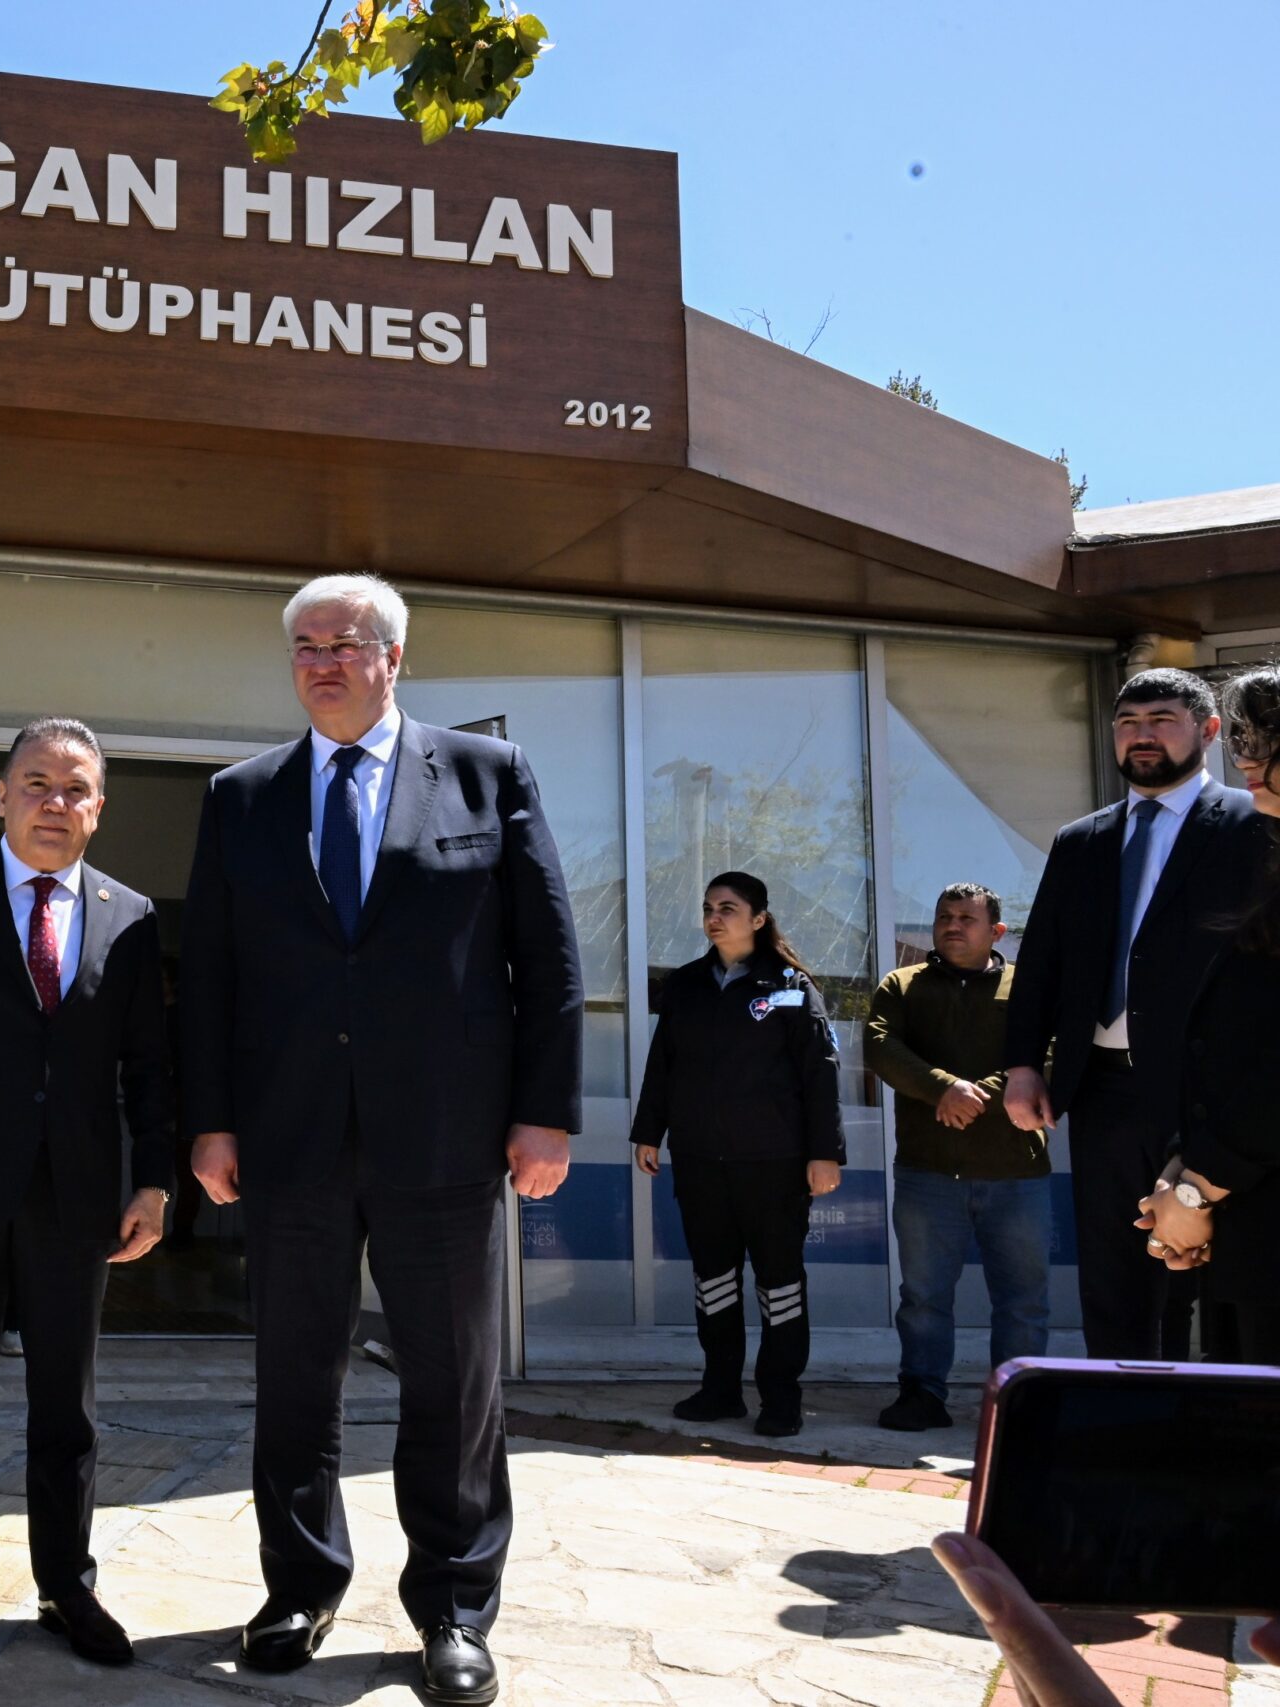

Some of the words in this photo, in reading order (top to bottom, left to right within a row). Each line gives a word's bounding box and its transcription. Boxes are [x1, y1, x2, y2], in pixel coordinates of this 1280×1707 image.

[222, 165, 614, 279] HIZLAN
[564, 399, 652, 431] 2012
[808, 1205, 846, 1225] EHİR
